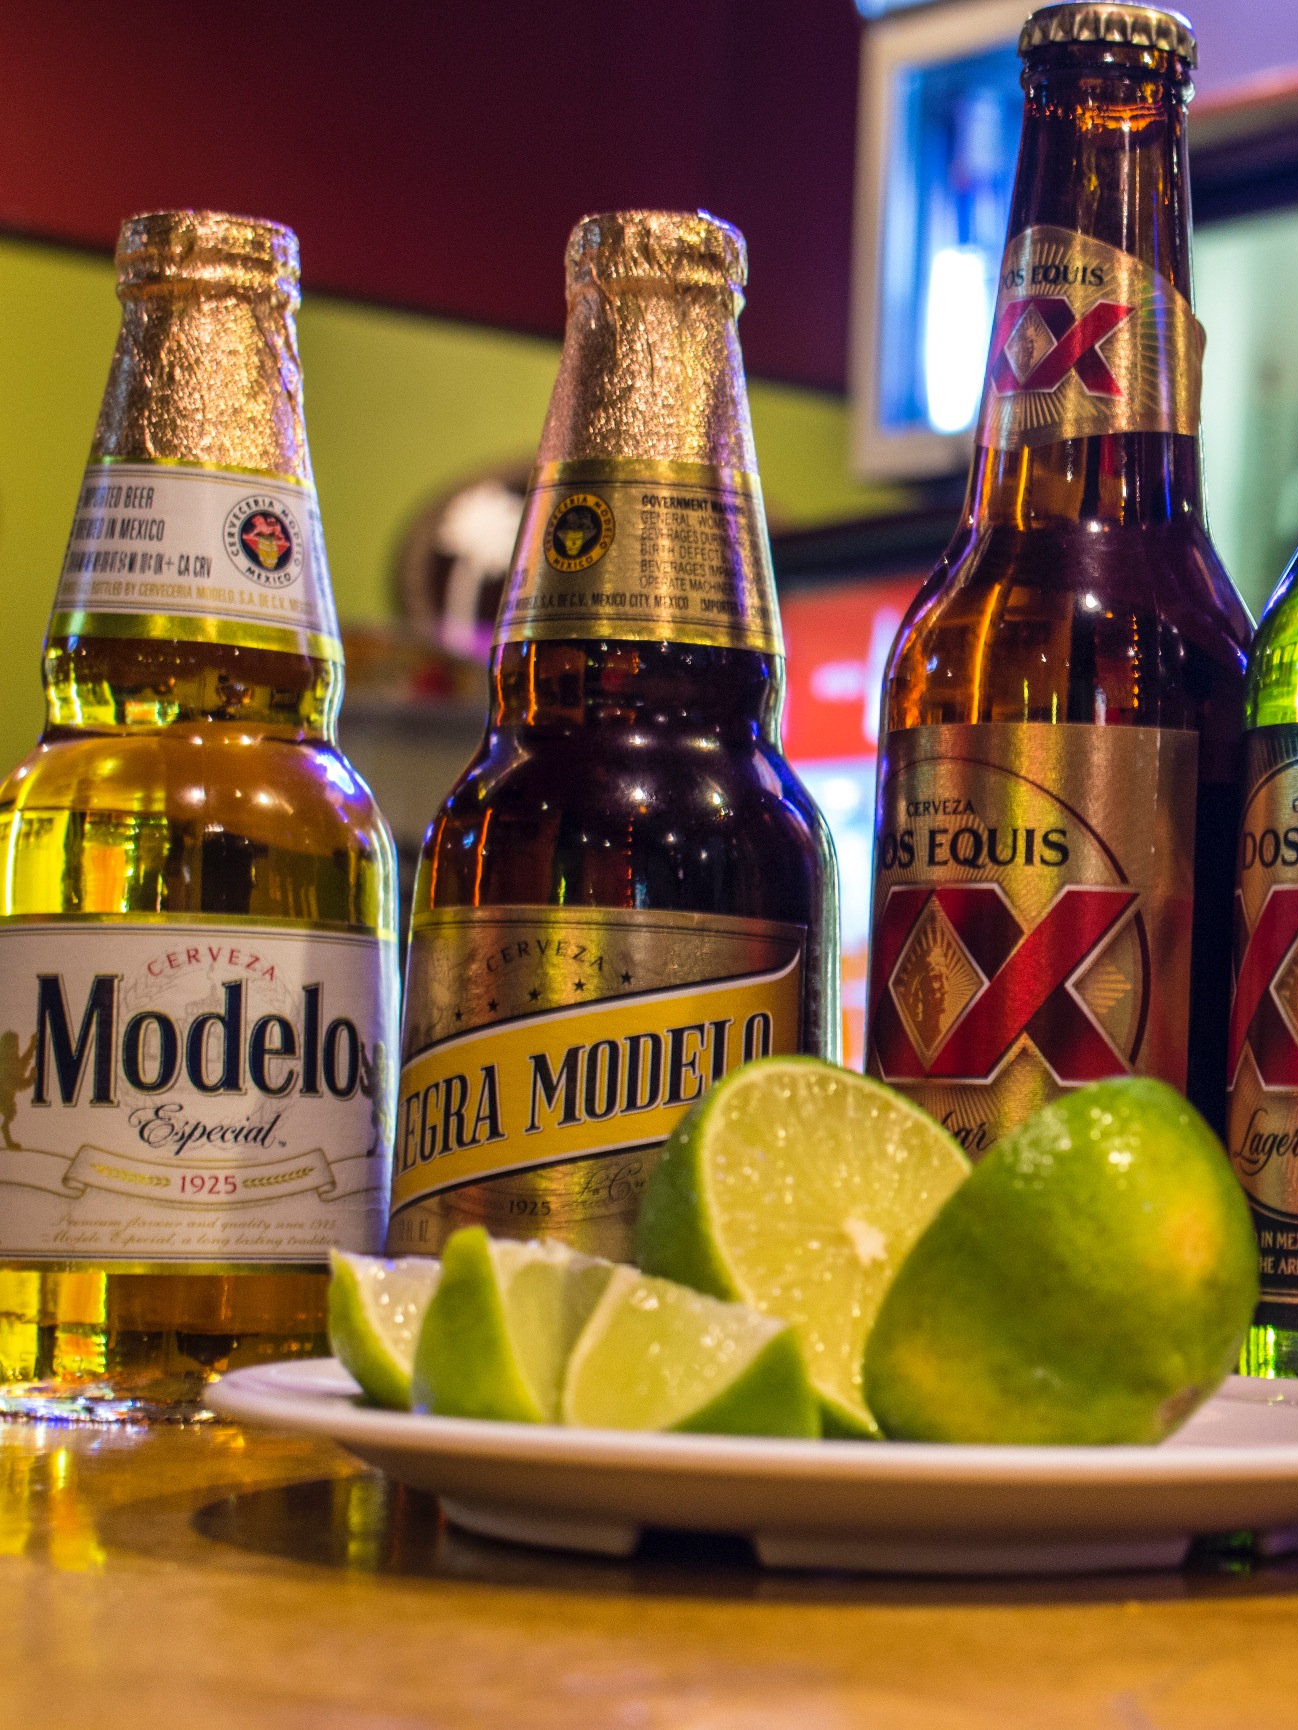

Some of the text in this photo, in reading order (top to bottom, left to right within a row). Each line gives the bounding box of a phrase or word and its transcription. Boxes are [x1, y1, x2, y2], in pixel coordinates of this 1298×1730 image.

[1031, 265, 1104, 287] EQUIS
[124, 486, 154, 510] BEER
[641, 495, 708, 511] GOVERNMENT
[119, 518, 165, 543] MEXICO
[227, 499, 275, 557] CERVECERIA
[641, 543, 675, 557] BIRTH
[178, 555, 190, 578] CA
[194, 555, 213, 579] CRV
[553, 556, 594, 569] MEXICO
[641, 560, 706, 577] BEVERAGES
[245, 565, 292, 585] MEXICO
[590, 592, 627, 608] MEXICO
[653, 594, 689, 611] MEXICO
[907, 800, 976, 818] CERVEZA
[928, 828, 1070, 869] EQUIS
[147, 945, 278, 982] CERVEZA
[487, 938, 605, 975] CERVEZA
[31, 972, 361, 1108] Modelo
[128, 1102, 283, 1157] Especial
[398, 1063, 508, 1176] EGRA
[179, 1174, 239, 1195] 1925
[508, 1199, 552, 1217] 1925
[186, 1215, 219, 1229] and
[221, 1217, 271, 1233] quality
[275, 1219, 305, 1230] since
[196, 1233, 231, 1251] long
[234, 1234, 284, 1250] lasting
[1261, 1231, 1274, 1248] IN
